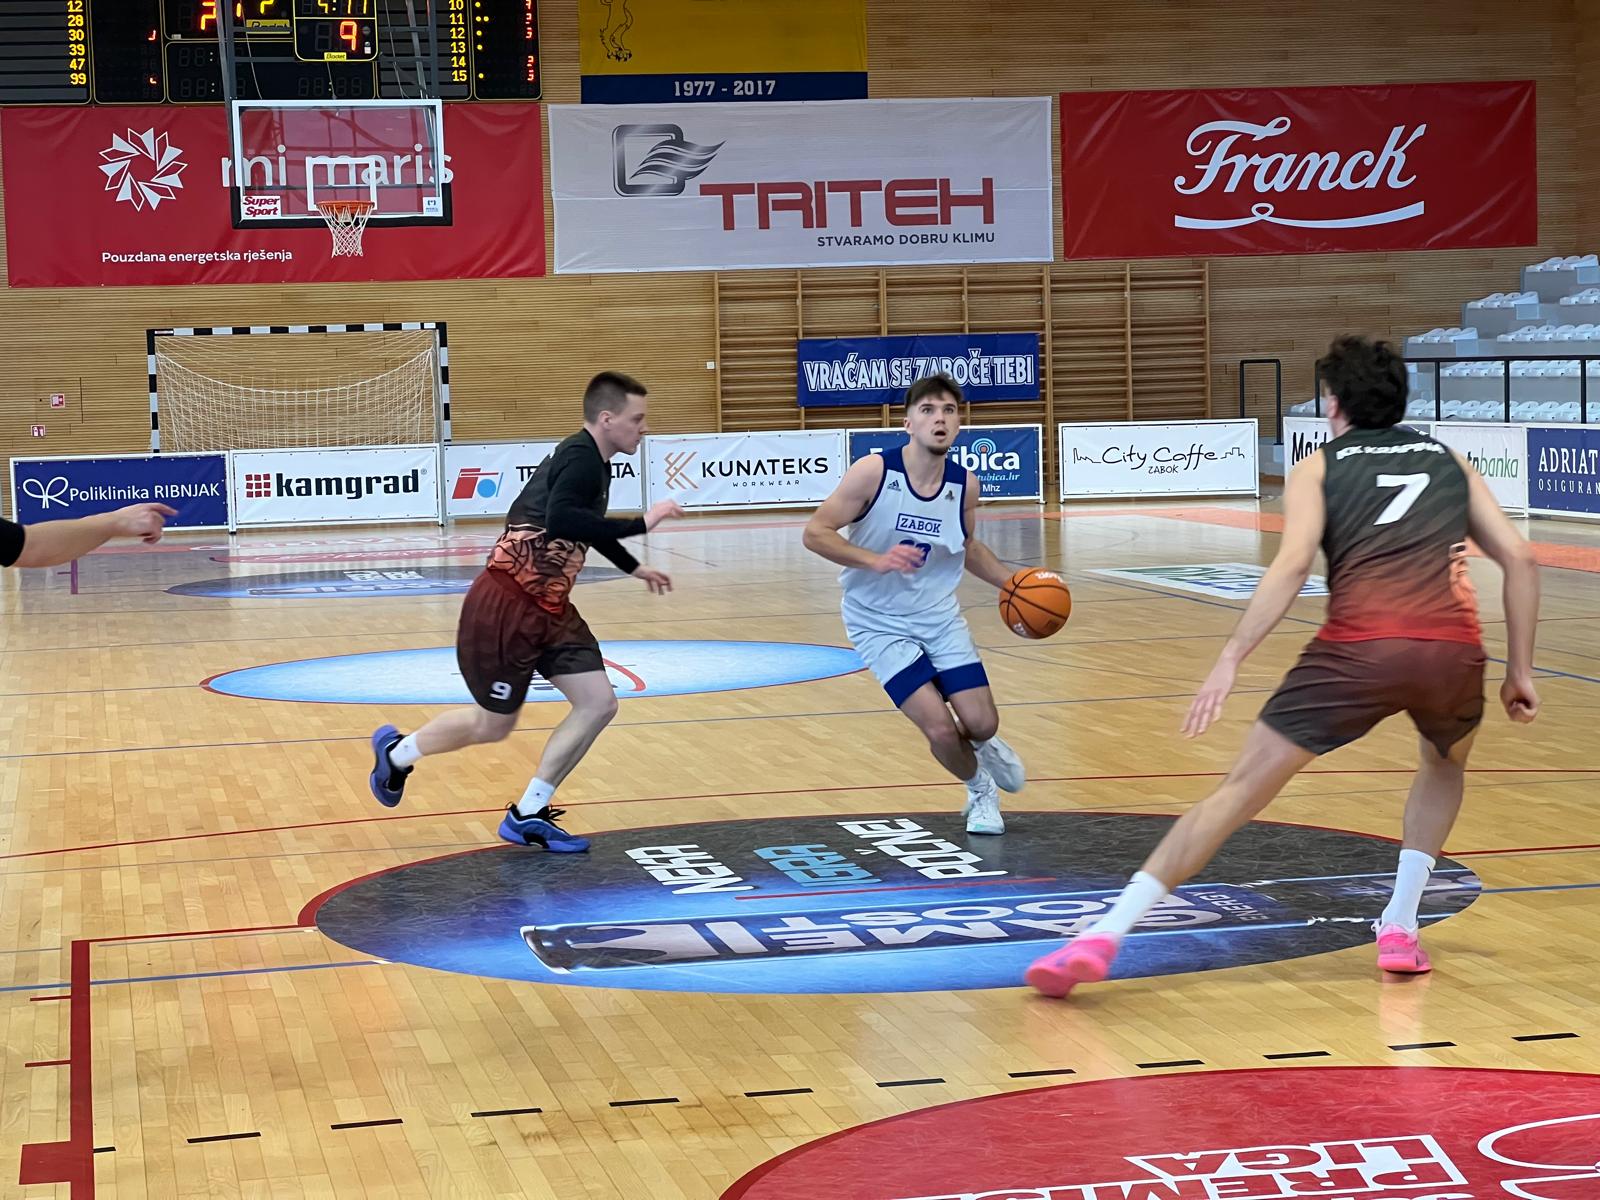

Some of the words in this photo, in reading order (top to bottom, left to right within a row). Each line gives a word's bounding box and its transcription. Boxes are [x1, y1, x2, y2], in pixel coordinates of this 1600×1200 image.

[67, 0, 83, 12] 12
[450, 0, 464, 10] 10
[67, 15, 84, 27] 28
[450, 13, 464, 25] 11
[68, 29, 85, 41] 30
[340, 21, 357, 51] 9
[450, 28, 465, 39] 12
[69, 44, 85, 56] 39
[450, 42, 466, 54] 13
[69, 59, 86, 70] 47
[451, 56, 466, 67] 14
[70, 73, 86, 85] 99
[452, 70, 467, 82] 15
[673, 80, 716, 97] 1977
[732, 79, 776, 96] 2017
[1173, 116, 1427, 195] Franck
[221, 144, 287, 188] mi
[305, 143, 454, 187] maris
[243, 196, 280, 207] Super
[700, 177, 994, 231] TRITEH
[245, 206, 279, 217] Sport
[817, 234, 895, 248] STVARAMO
[898, 233, 949, 246] DOBRU
[952, 231, 996, 244] KLIMU
[102, 251, 167, 264] Pouzdana
[169, 250, 241, 265] energetska
[243, 249, 293, 264] rješenja
[803, 353, 888, 391] VRAĆAM
[890, 358, 913, 389] SE
[991, 354, 1035, 386] TEBI
[1102, 444, 1148, 470] City
[1153, 443, 1218, 471] Caffe
[701, 456, 829, 479] KUNATEKS
[1148, 465, 1179, 474] ZABOK
[732, 479, 801, 488] WORKWEAR
[70, 484, 149, 502] Poliklinika
[154, 482, 220, 499] RIBNJAK
[1373, 472, 1431, 525] 7
[900, 517, 941, 534] ZABOK
[490, 681, 512, 700] 9
[624, 843, 755, 895] NEKA
[753, 843, 882, 888] IGRA
[1187, 890, 1269, 921] ENERGY
[1141, 1138, 1435, 1177] LIGA
